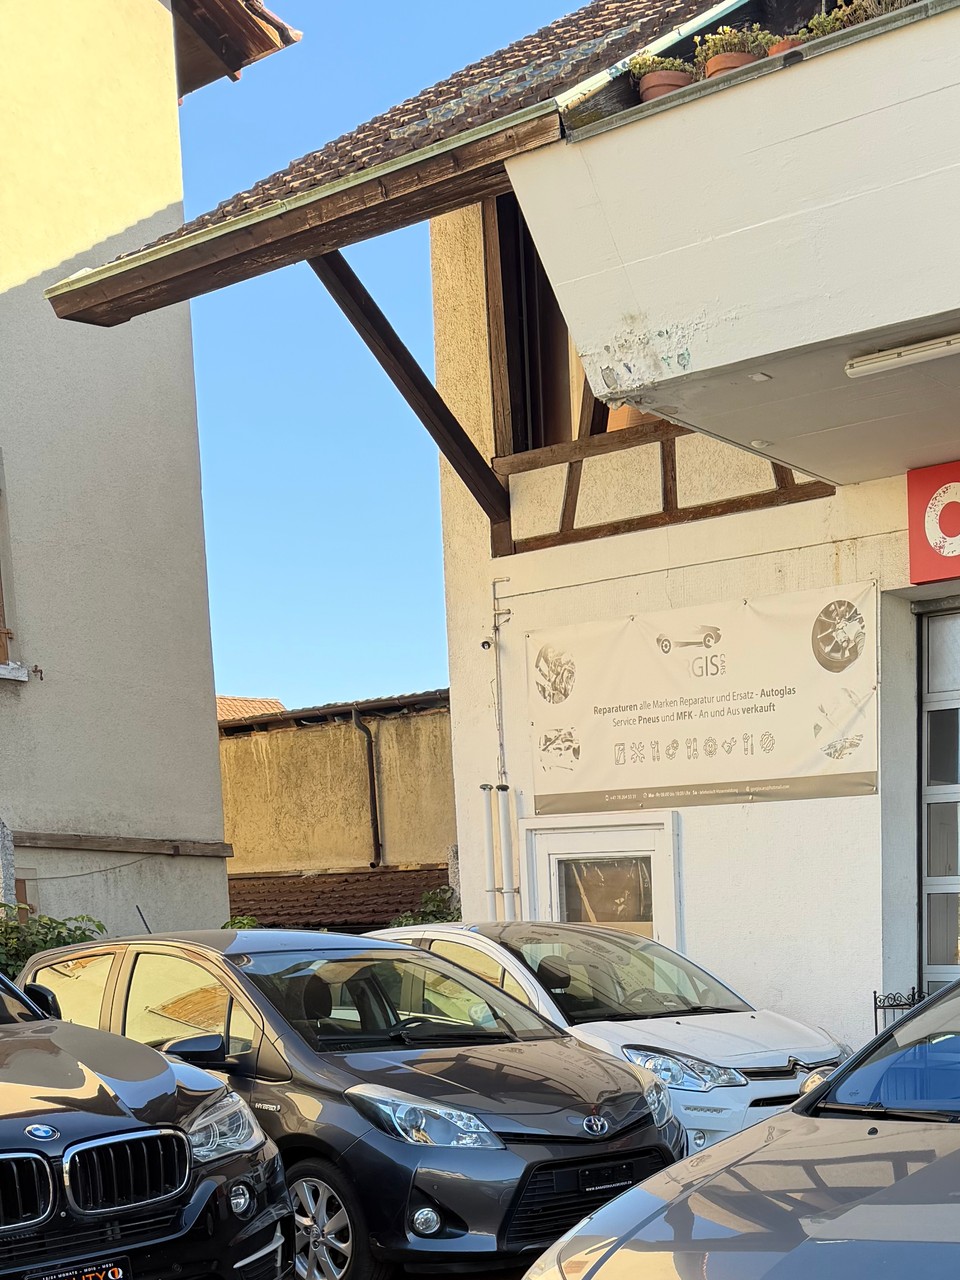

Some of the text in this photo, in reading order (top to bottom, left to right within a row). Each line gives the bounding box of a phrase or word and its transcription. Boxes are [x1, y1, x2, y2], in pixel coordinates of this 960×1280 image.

[719, 653, 727, 676] CARS
[593, 703, 638, 716] Reparaturen
[639, 701, 652, 710] alle
[652, 699, 678, 709] Marken
[679, 696, 715, 707] Reparatur
[716, 692, 731, 702] und
[732, 691, 754, 701] Ersatz
[760, 685, 796, 698] Autoglas
[612, 717, 637, 727] Service
[637, 715, 660, 724] Pneus
[660, 712, 675, 722] und
[676, 711, 693, 721] MFK
[699, 709, 709, 718] An
[710, 708, 725, 718] und
[726, 707, 740, 716] Aus
[741, 702, 776, 714] verkauft
[255, 1102, 277, 1112] HYBRID
